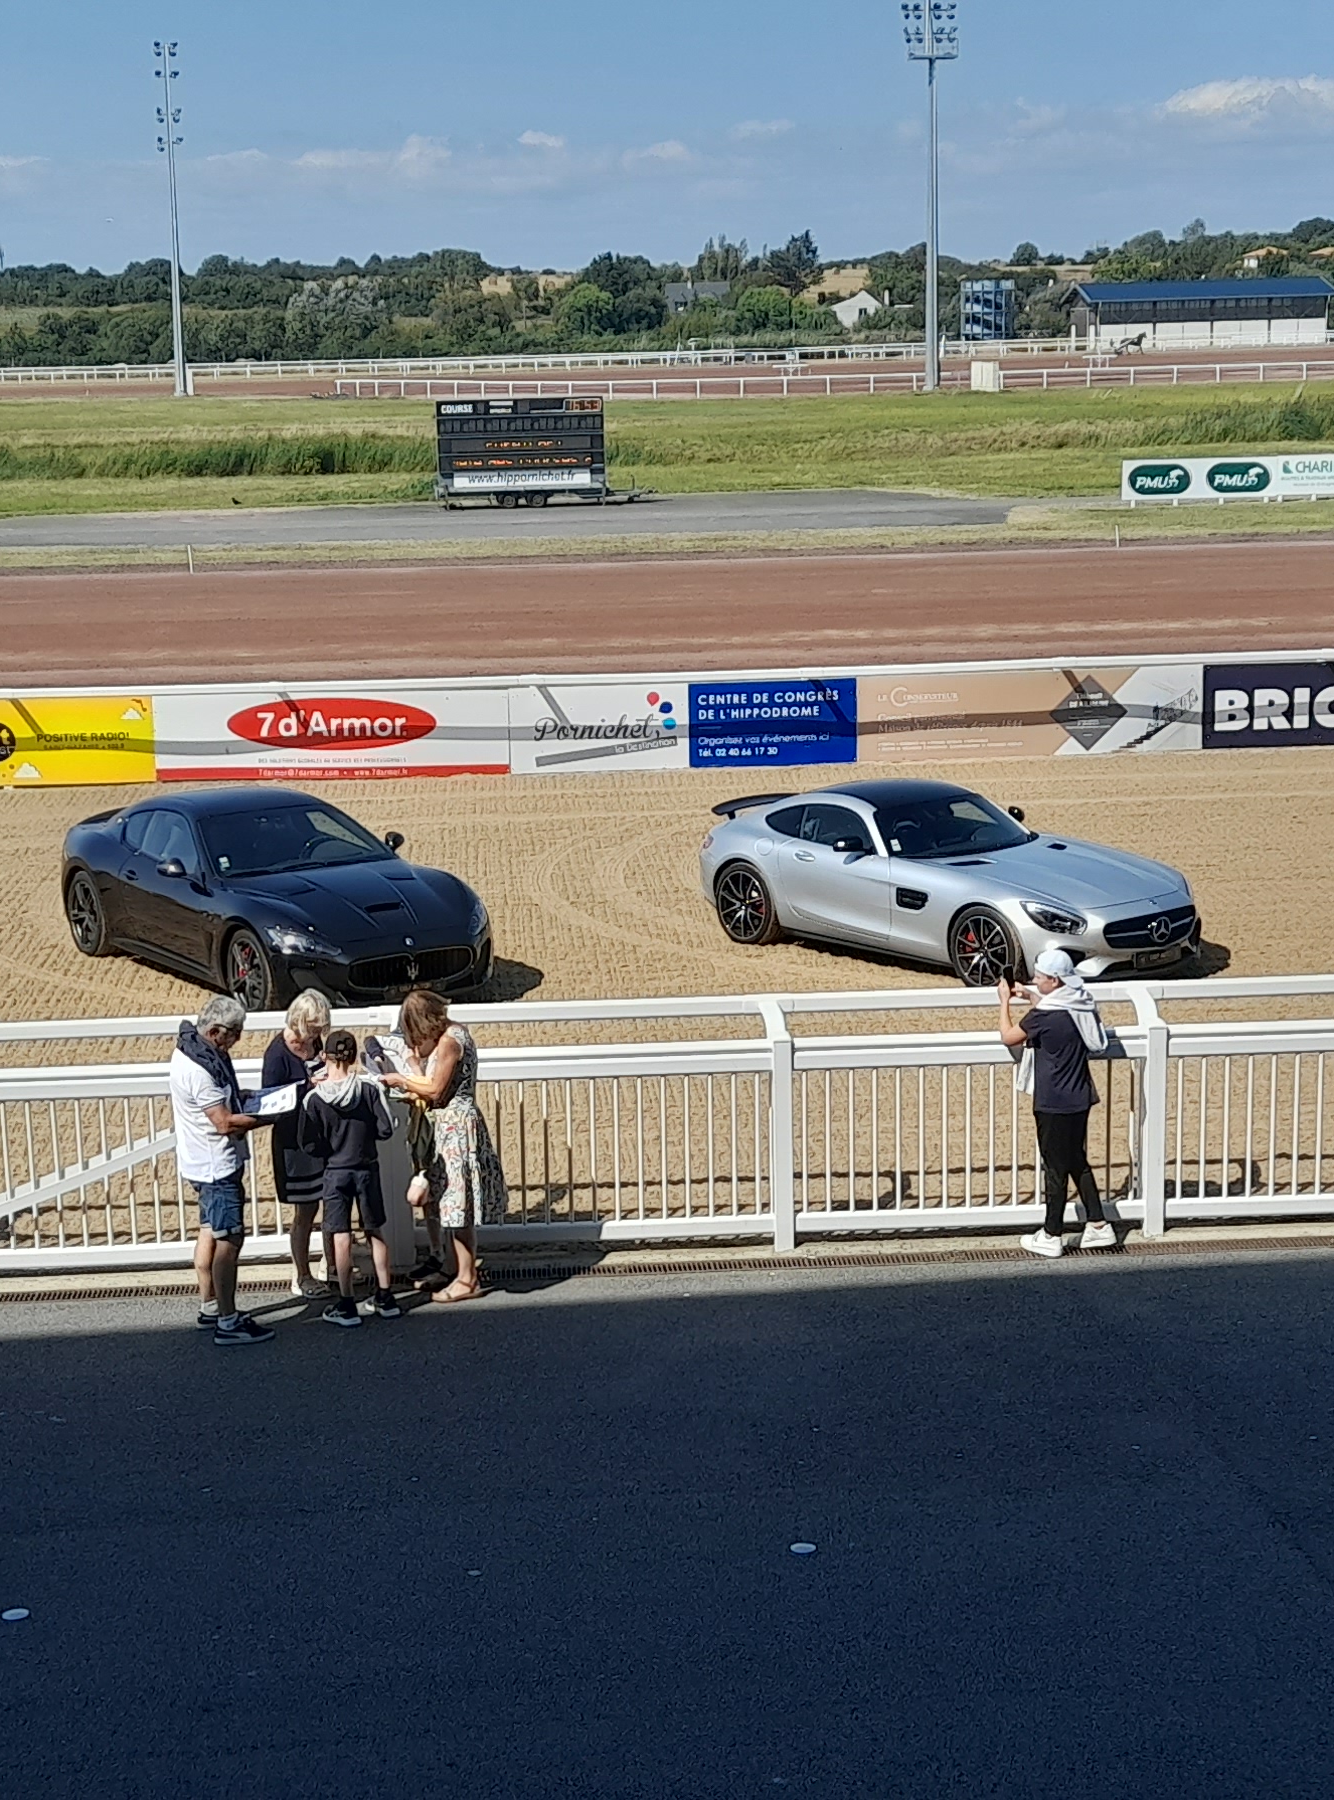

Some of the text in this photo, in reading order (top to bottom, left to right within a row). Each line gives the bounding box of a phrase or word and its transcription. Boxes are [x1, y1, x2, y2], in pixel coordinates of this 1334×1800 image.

[440, 403, 474, 414] COURSE
[1135, 475, 1169, 489] PMU
[1213, 473, 1248, 487] PMU
[698, 687, 839, 706] CENTRE DE CONGRÈS
[698, 705, 820, 720] DE L'HIPPODROME
[698, 736, 743, 747] Organisez
[715, 748, 727, 756] 02
[755, 747, 765, 755] 17
